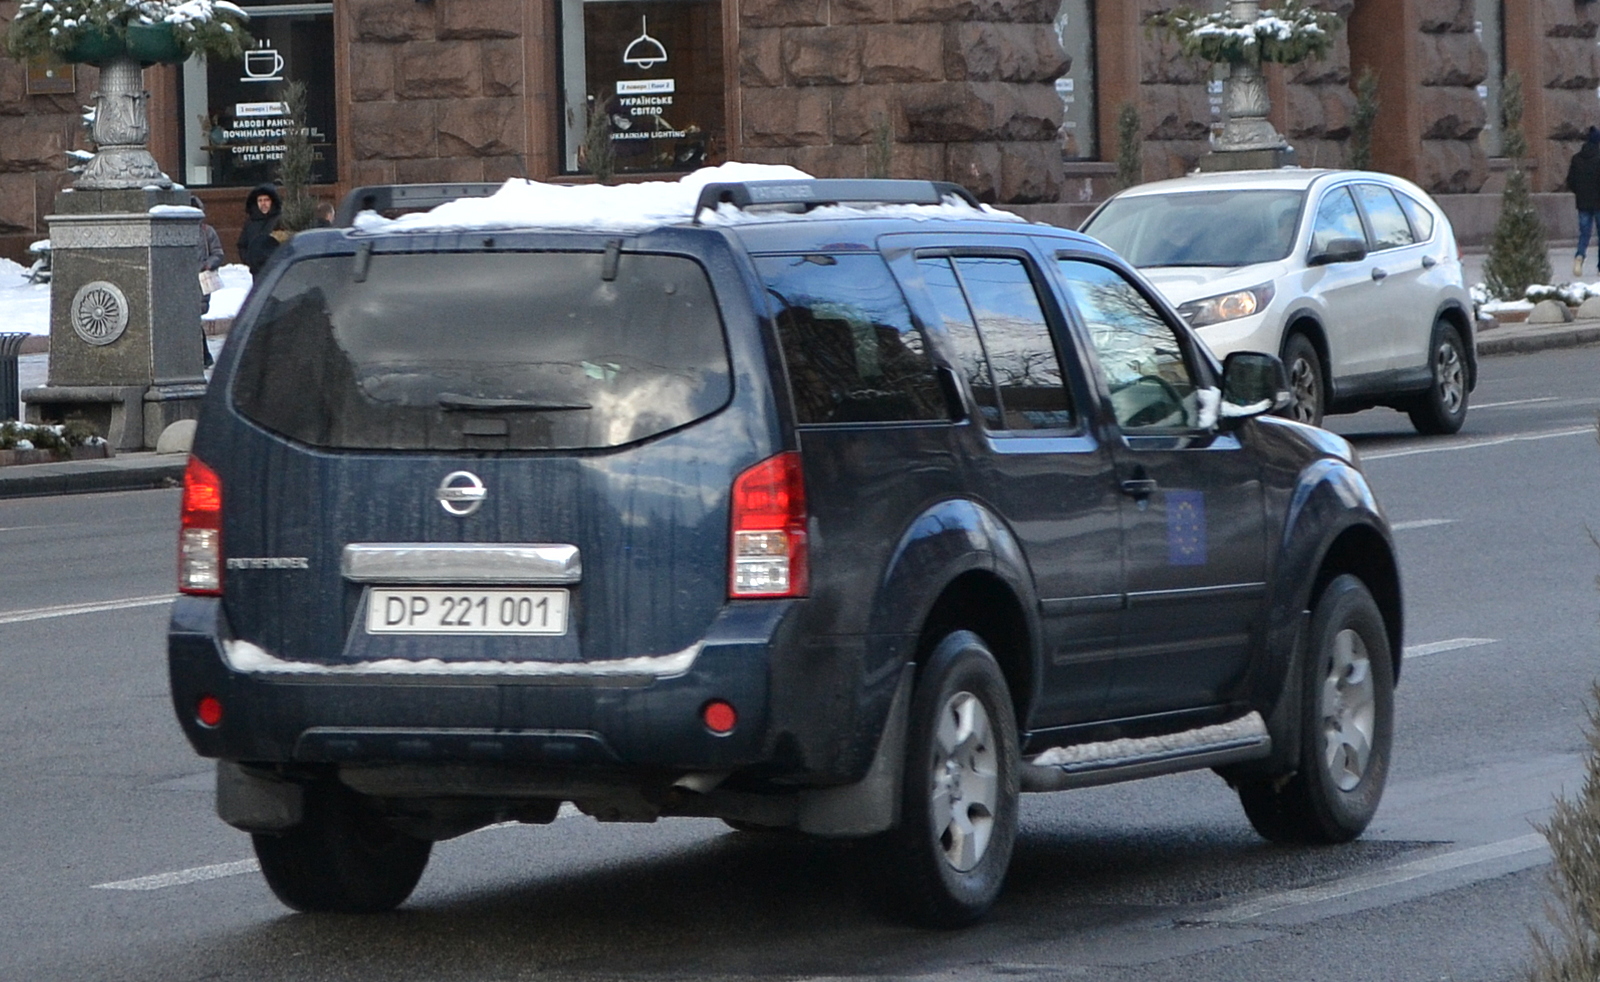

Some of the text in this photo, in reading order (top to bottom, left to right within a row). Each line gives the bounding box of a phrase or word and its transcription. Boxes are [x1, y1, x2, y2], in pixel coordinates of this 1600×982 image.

[620, 96, 673, 106] УКРАЇНСЬКЕ
[631, 107, 663, 115] СВІТЛО
[233, 120, 264, 128] КАВОВІ
[610, 132, 650, 140] UKRAINIAN
[232, 145, 259, 153] COFFEE
[243, 153, 264, 161] START
[386, 596, 549, 626] DP 221 001
